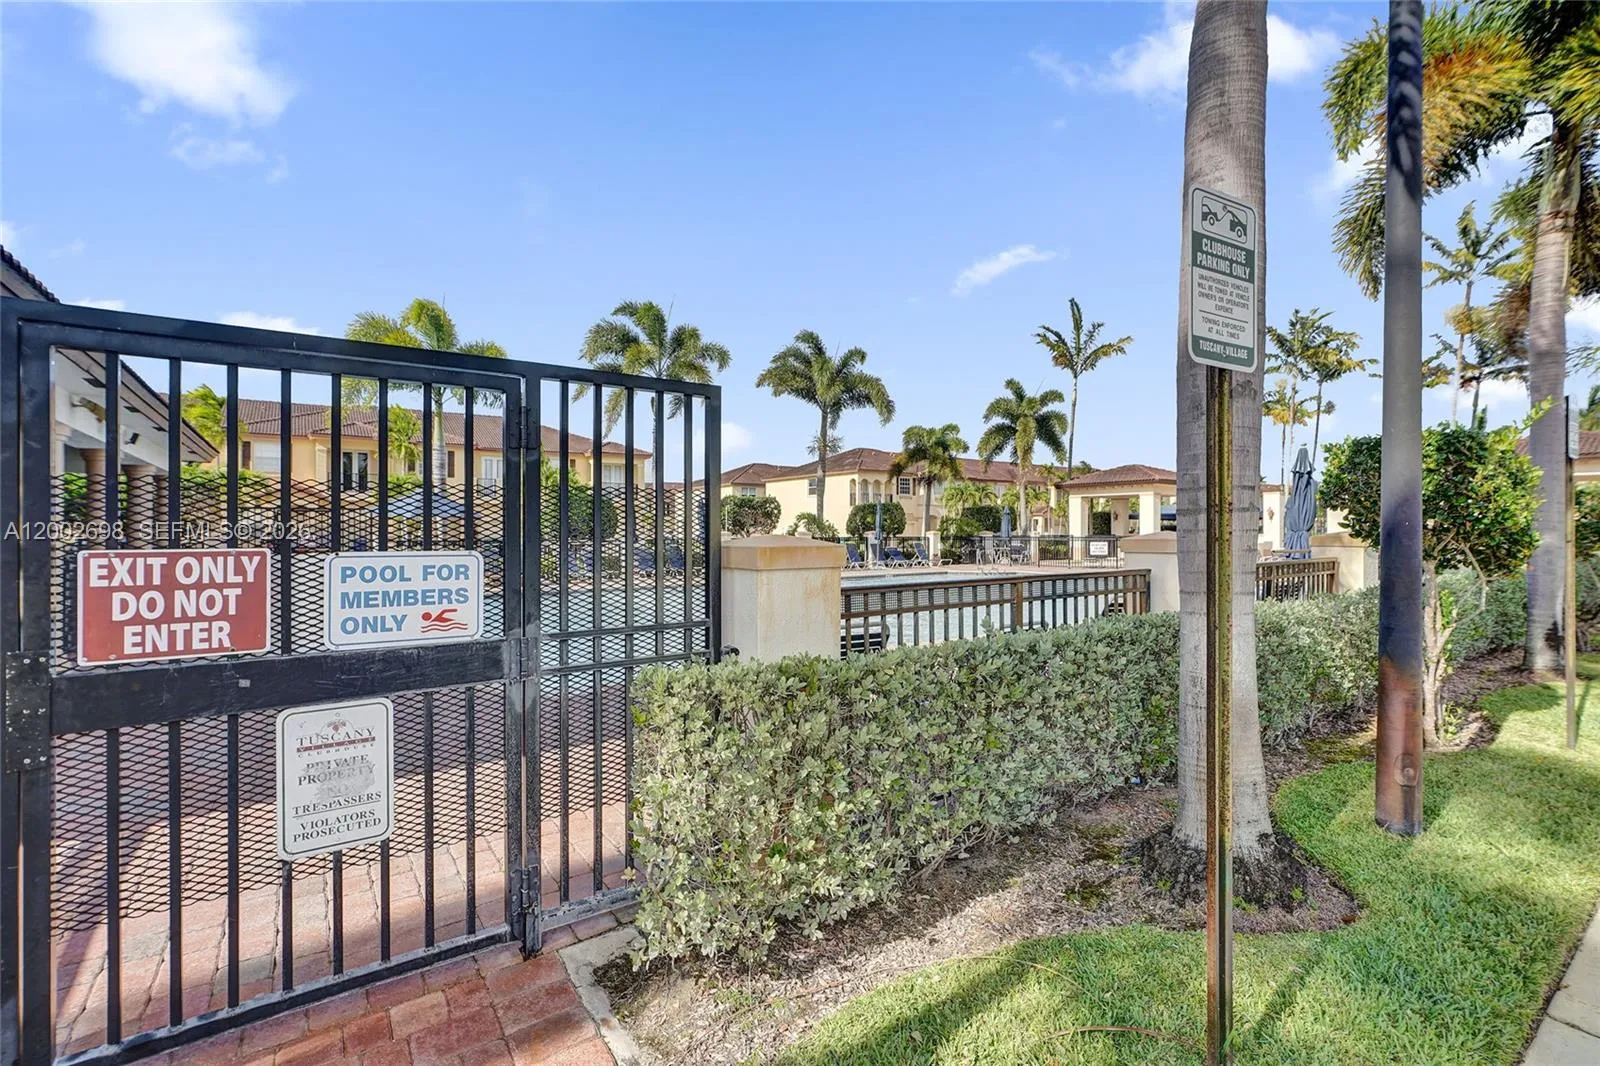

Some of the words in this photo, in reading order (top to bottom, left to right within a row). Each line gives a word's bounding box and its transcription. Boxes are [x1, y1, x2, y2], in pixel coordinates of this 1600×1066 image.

[1202, 238, 1246, 264] CLUBHOUSE
[1197, 251, 1231, 274] PARKING
[1232, 263, 1250, 280] ONLY
[1202, 316, 1220, 326] TOWING
[1222, 321, 1246, 332] ENFORCED
[1216, 328, 1224, 336] ALL
[1226, 331, 1240, 340] TIMES
[1199, 340, 1224, 354] TUSCANY
[1225, 346, 1248, 359] VILLAGE
[89, 557, 168, 588] EXIT
[175, 555, 261, 585] ONLY
[340, 565, 412, 584] POOL
[422, 563, 470, 582] FOR
[111, 590, 165, 622] DO
[174, 588, 242, 618] NOT
[340, 587, 469, 609] MEMBERS
[341, 614, 408, 635] ONLY
[124, 620, 232, 655] ENTER
[296, 727, 375, 746] TUSCANY
[298, 763, 375, 786] PROPERTY
[292, 791, 382, 815] TRESPASSERS
[293, 818, 382, 842] PROSECUTED
[300, 809, 375, 831] VIOLATORS
